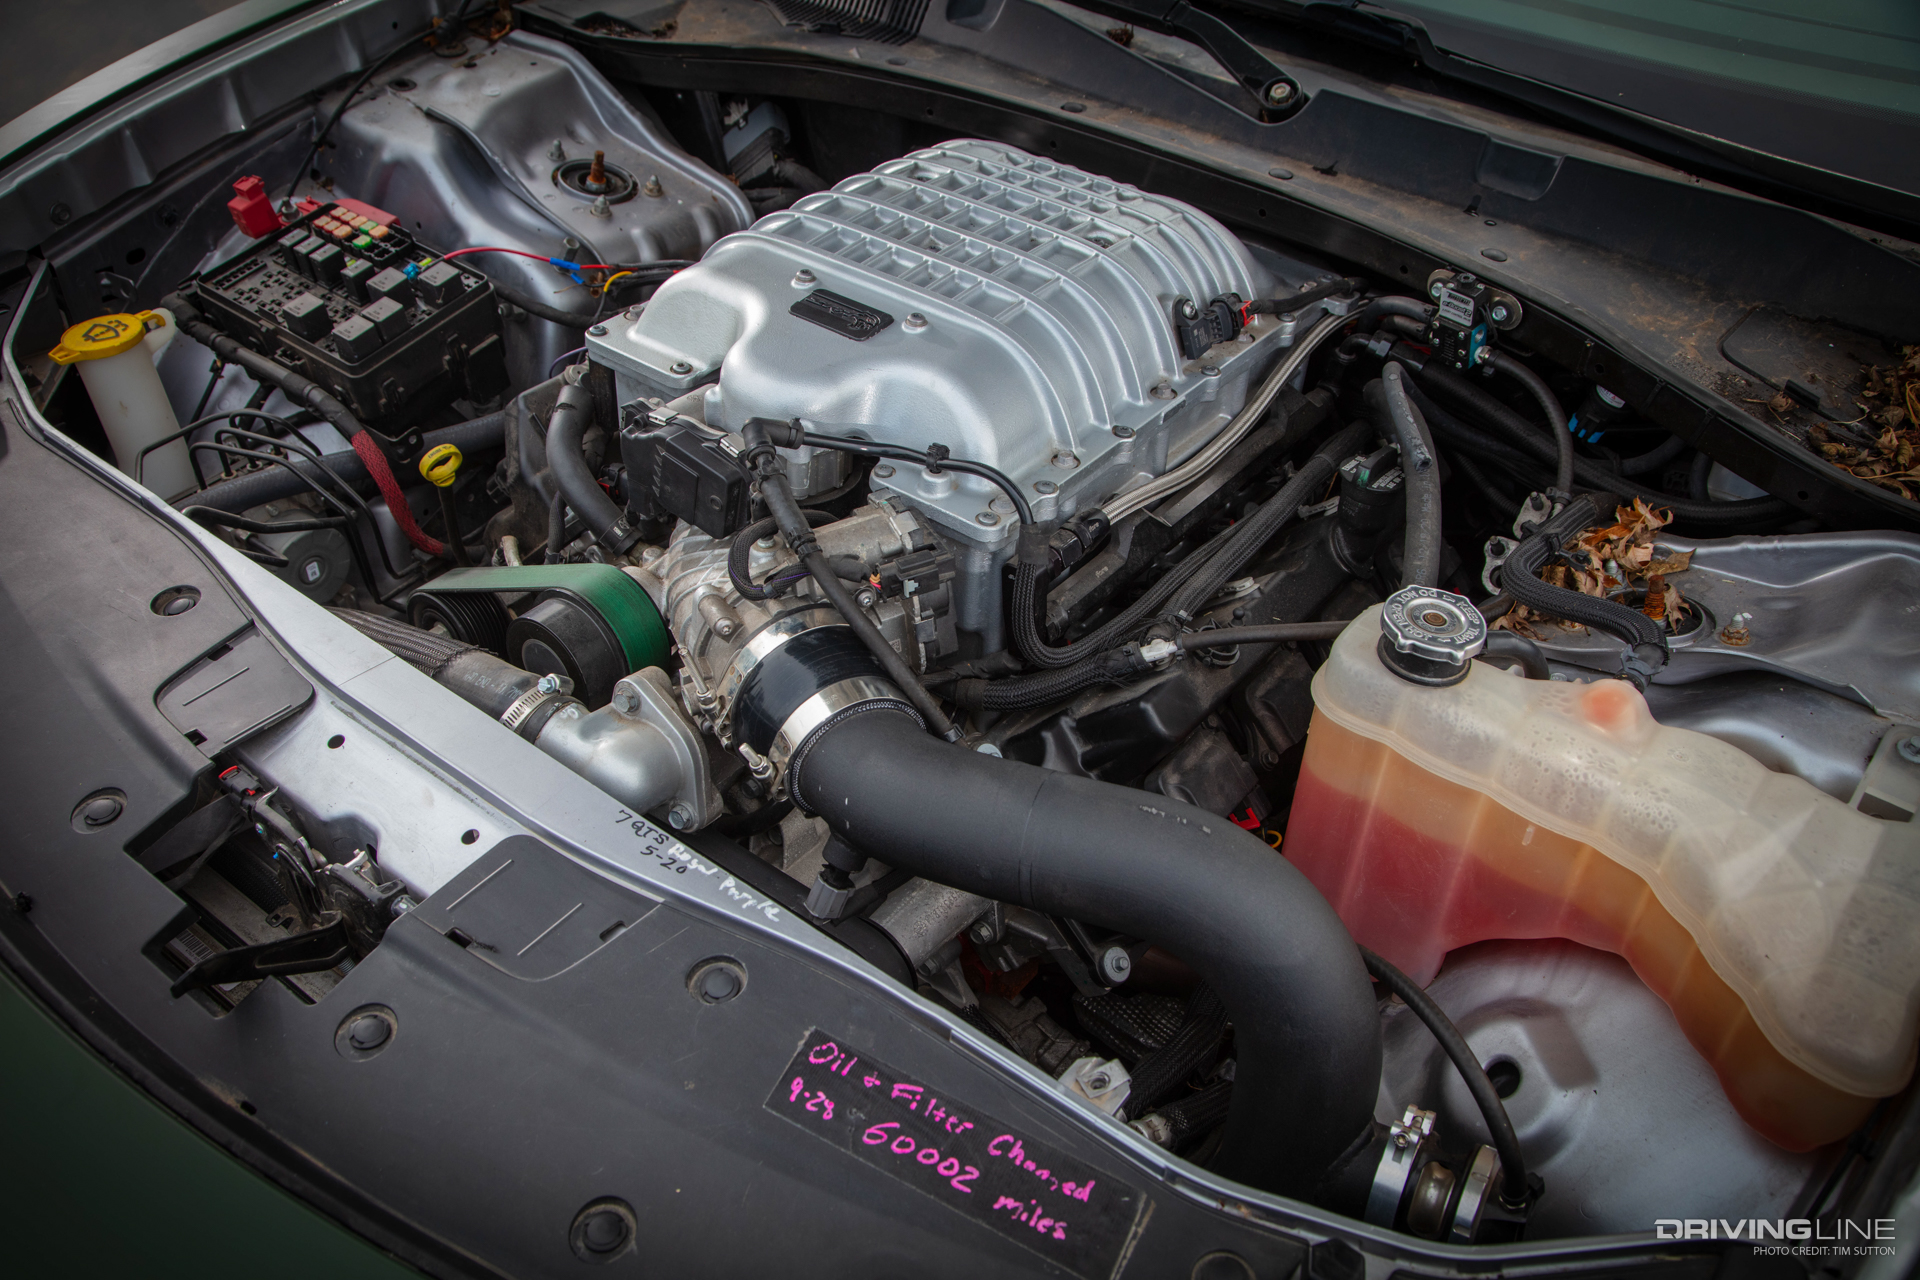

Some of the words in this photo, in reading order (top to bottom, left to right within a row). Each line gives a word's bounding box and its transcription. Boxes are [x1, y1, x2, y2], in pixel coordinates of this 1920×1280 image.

[1400, 589, 1419, 604] NOT
[1418, 589, 1438, 598] DO
[1391, 603, 1409, 626] OPEN
[1456, 601, 1480, 625] KEEP
[1404, 625, 1432, 641] HOT
[1453, 627, 1480, 644] TIGHT
[615, 809, 633, 824] 7
[631, 821, 669, 845] QTS
[640, 845, 688, 874] 5-20
[808, 1042, 858, 1077] Oil
[891, 1083, 974, 1134] Filter
[987, 1134, 1096, 1202] Changed
[862, 1121, 980, 1193] 60002
[993, 1195, 1067, 1240] miles
